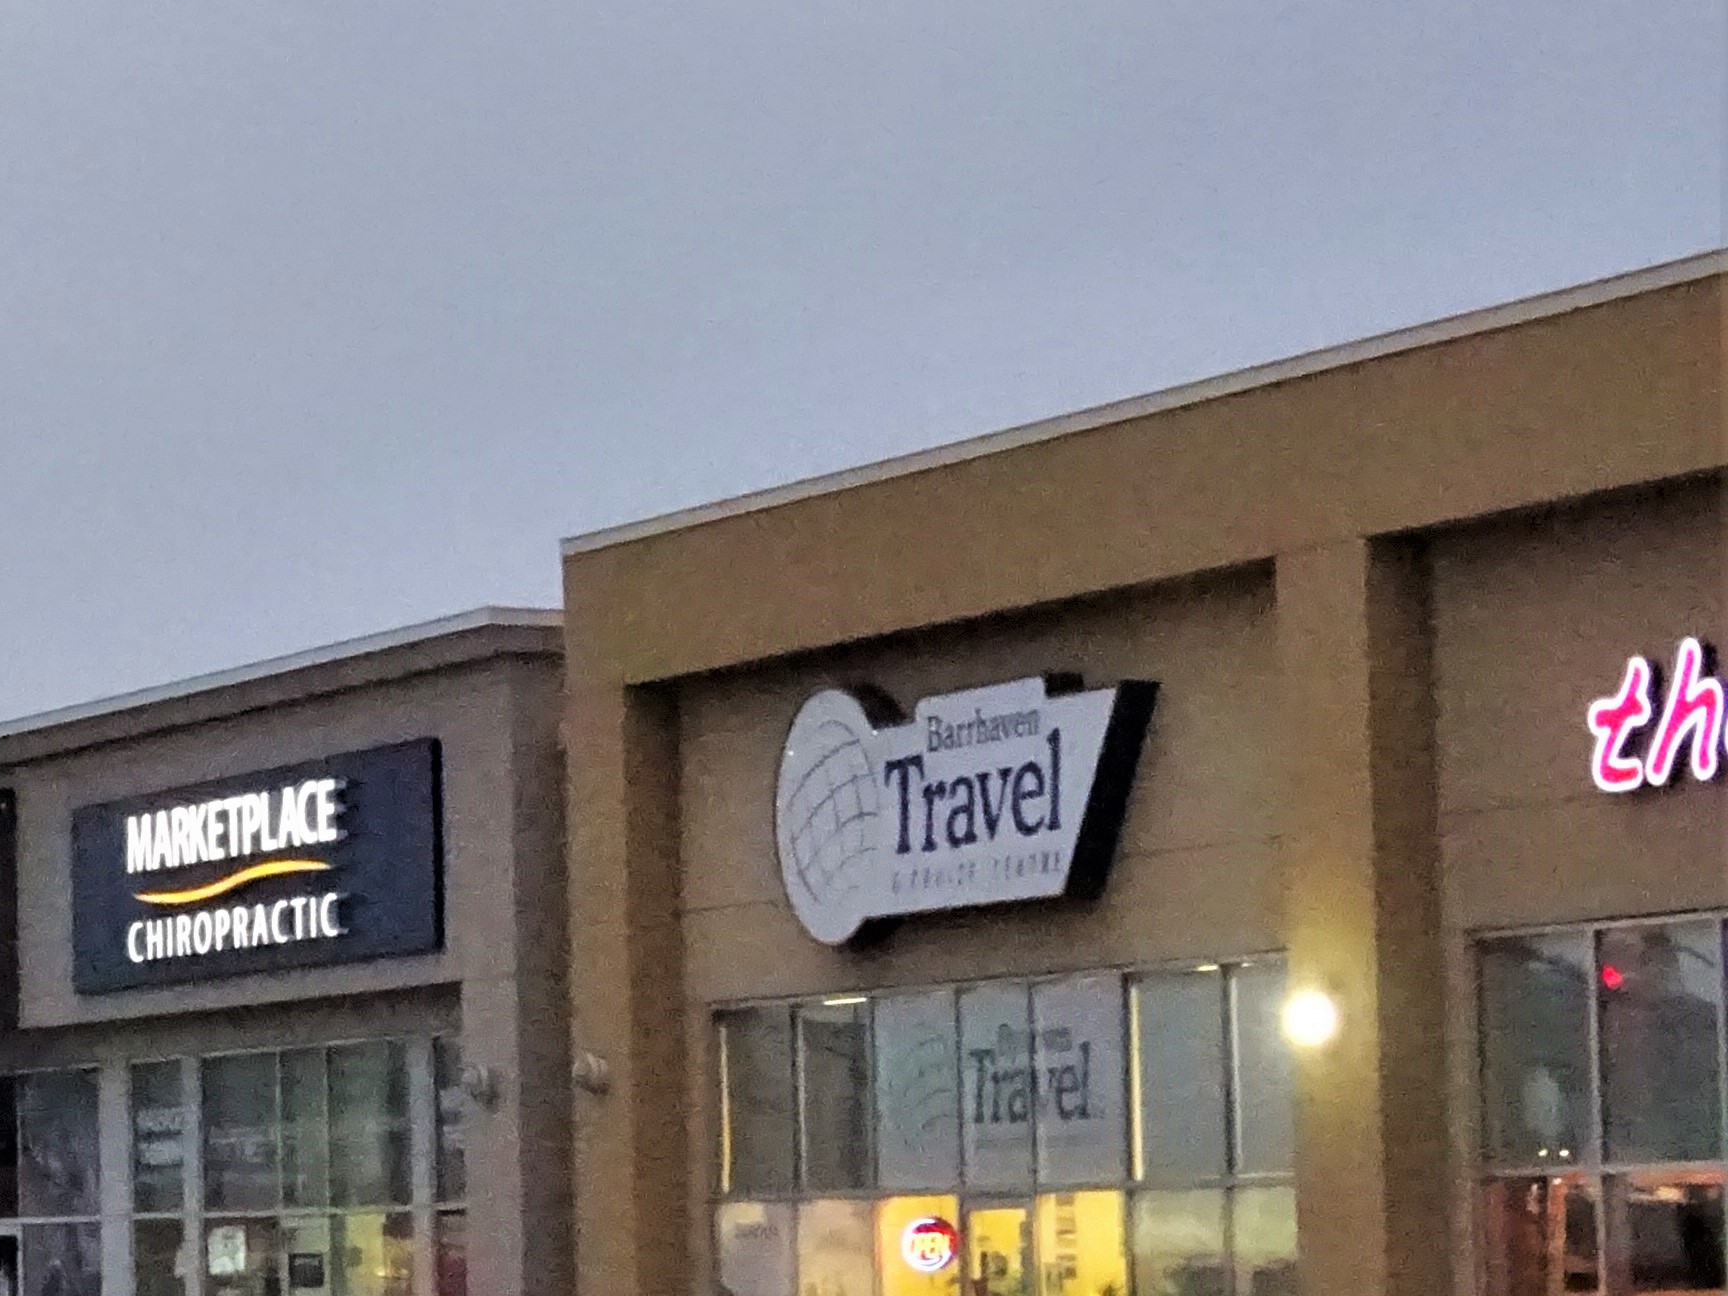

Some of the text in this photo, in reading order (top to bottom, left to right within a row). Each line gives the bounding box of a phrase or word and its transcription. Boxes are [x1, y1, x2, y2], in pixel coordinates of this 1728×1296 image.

[927, 709, 1040, 752] Barrhaven
[1588, 637, 1728, 791] th
[127, 778, 338, 874] MARKETPLACE
[884, 727, 1062, 854] Travel
[127, 892, 339, 963] CHIROPRACTIC
[910, 1231, 950, 1260] OPEN
